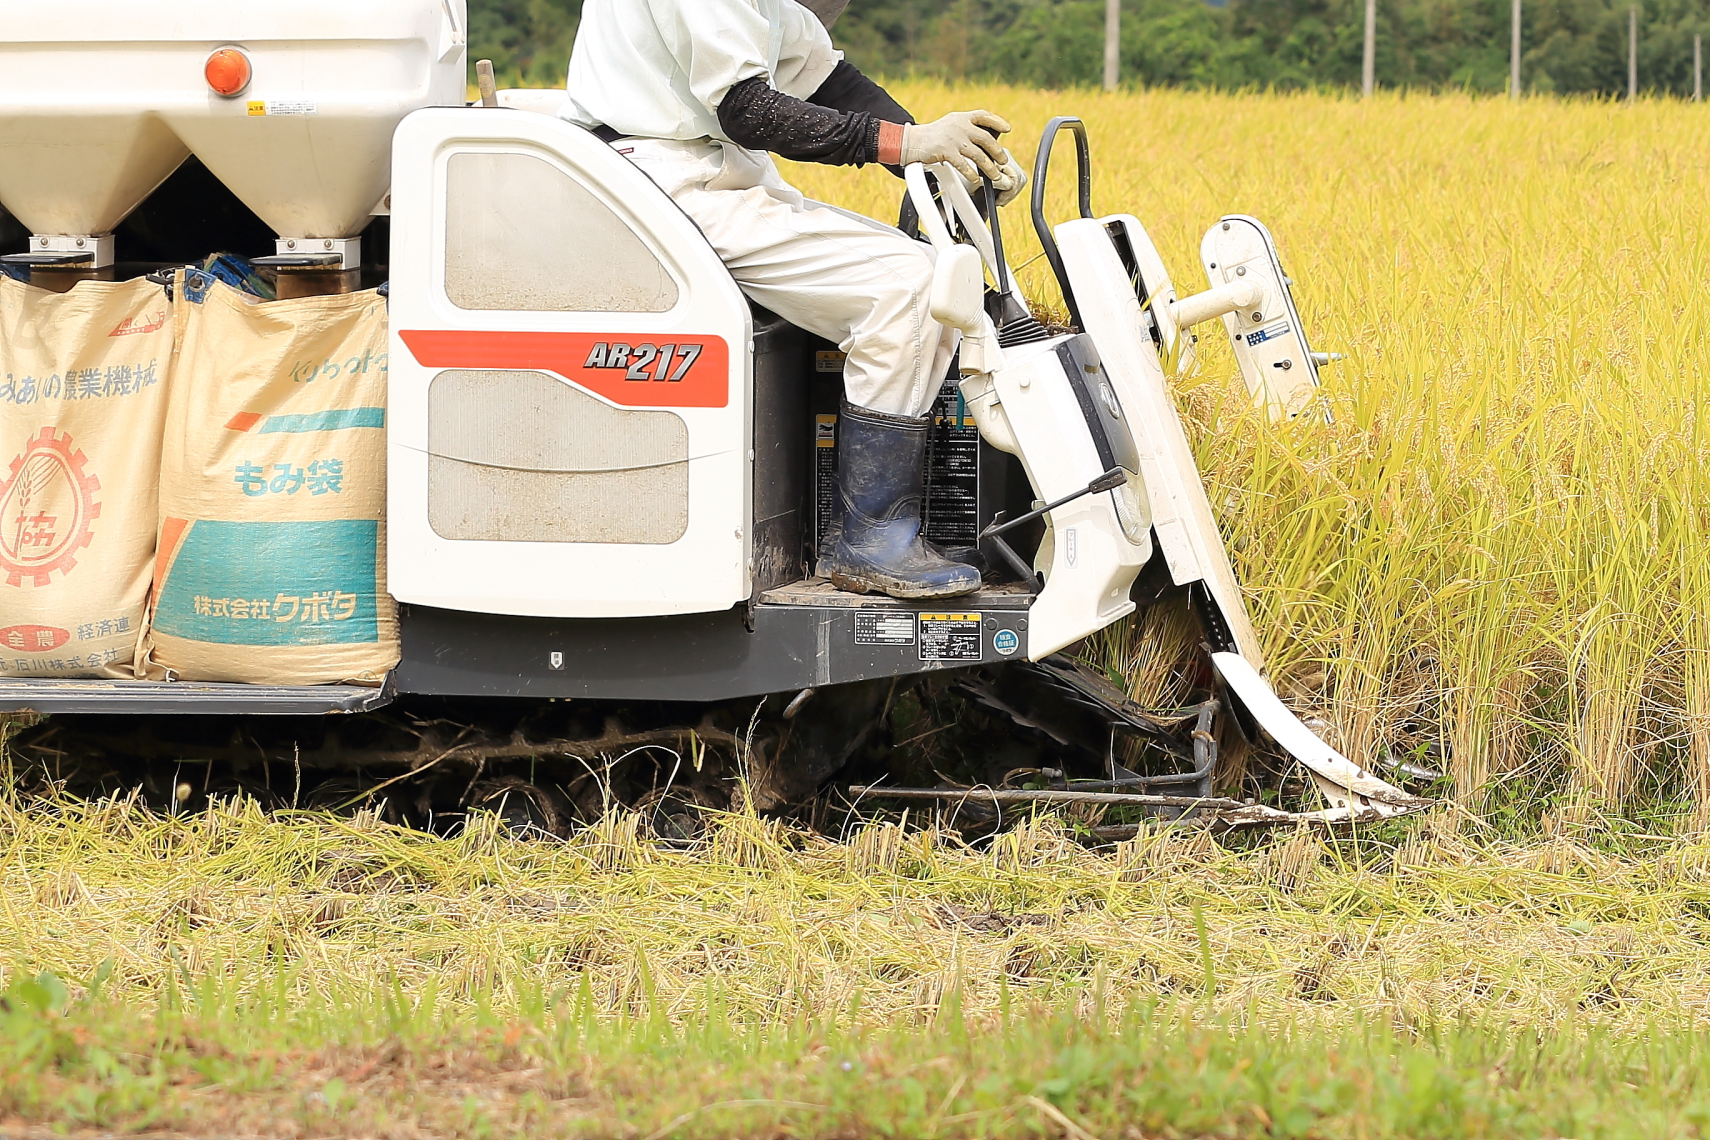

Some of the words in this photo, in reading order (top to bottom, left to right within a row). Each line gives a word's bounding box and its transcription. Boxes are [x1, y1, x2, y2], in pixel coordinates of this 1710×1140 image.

[583, 342, 703, 382] AR217
[234, 458, 344, 497] もみ袋
[193, 590, 357, 623] 株式会社クボタ
[7, 630, 55, 647] 全農
[76, 615, 130, 641] 経済連
